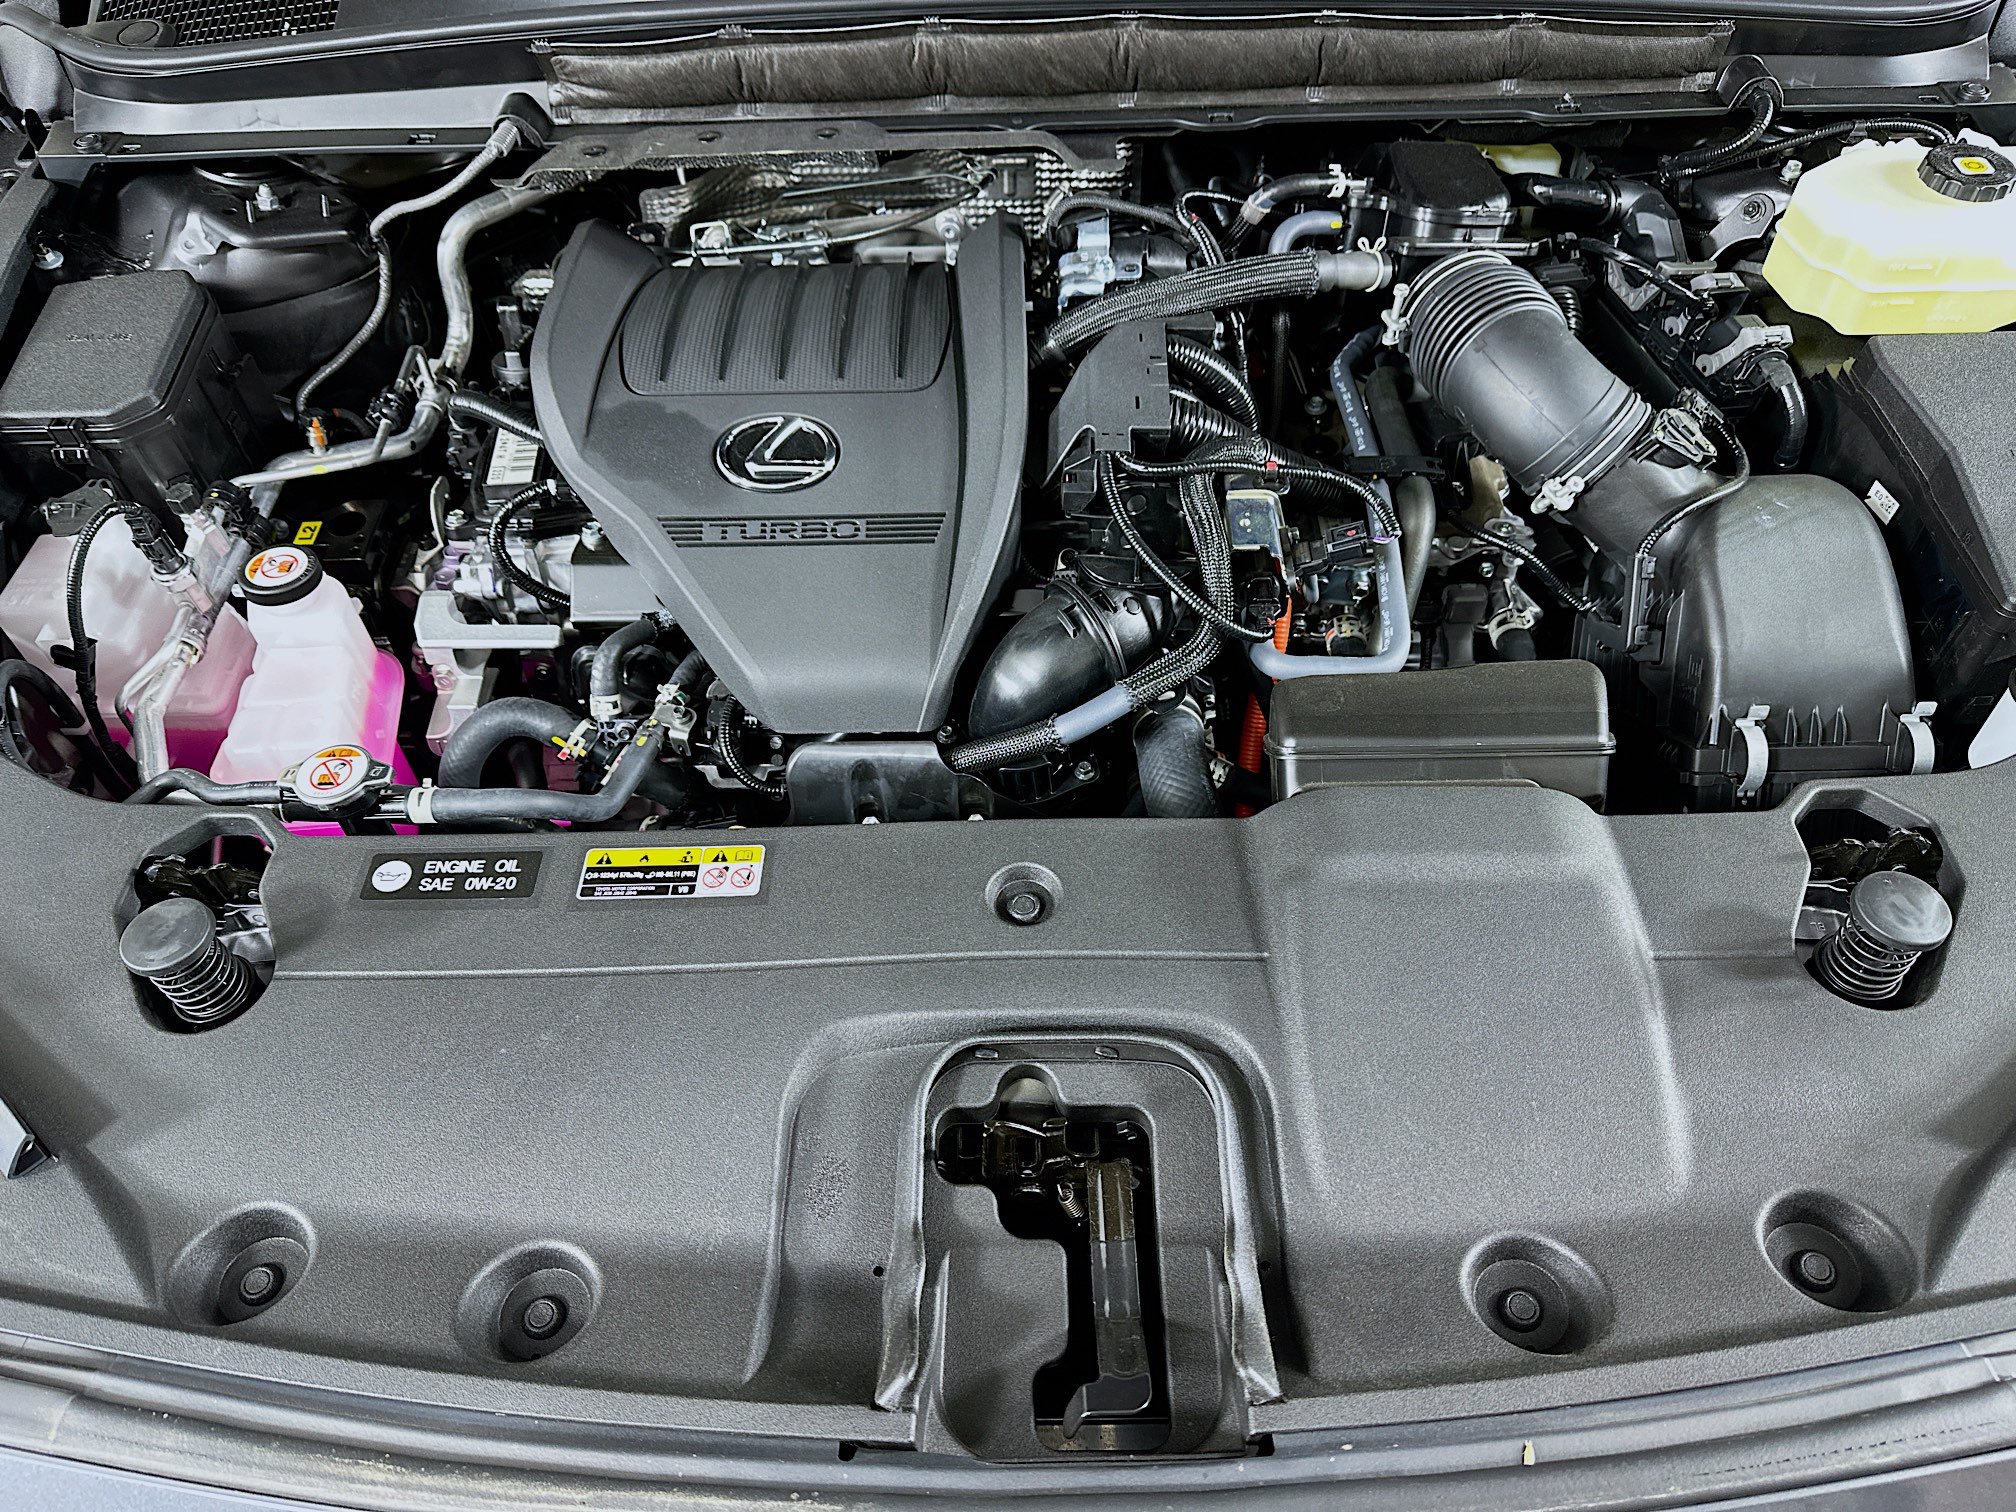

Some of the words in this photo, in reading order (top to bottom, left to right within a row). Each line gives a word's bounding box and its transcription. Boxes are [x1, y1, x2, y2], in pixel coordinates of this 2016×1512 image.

[298, 525, 317, 540] L2
[709, 519, 861, 540] TURBO
[423, 859, 487, 875] ENGINE
[494, 859, 522, 873] OIL
[418, 877, 455, 892] SAE
[464, 876, 518, 891] 0W-20
